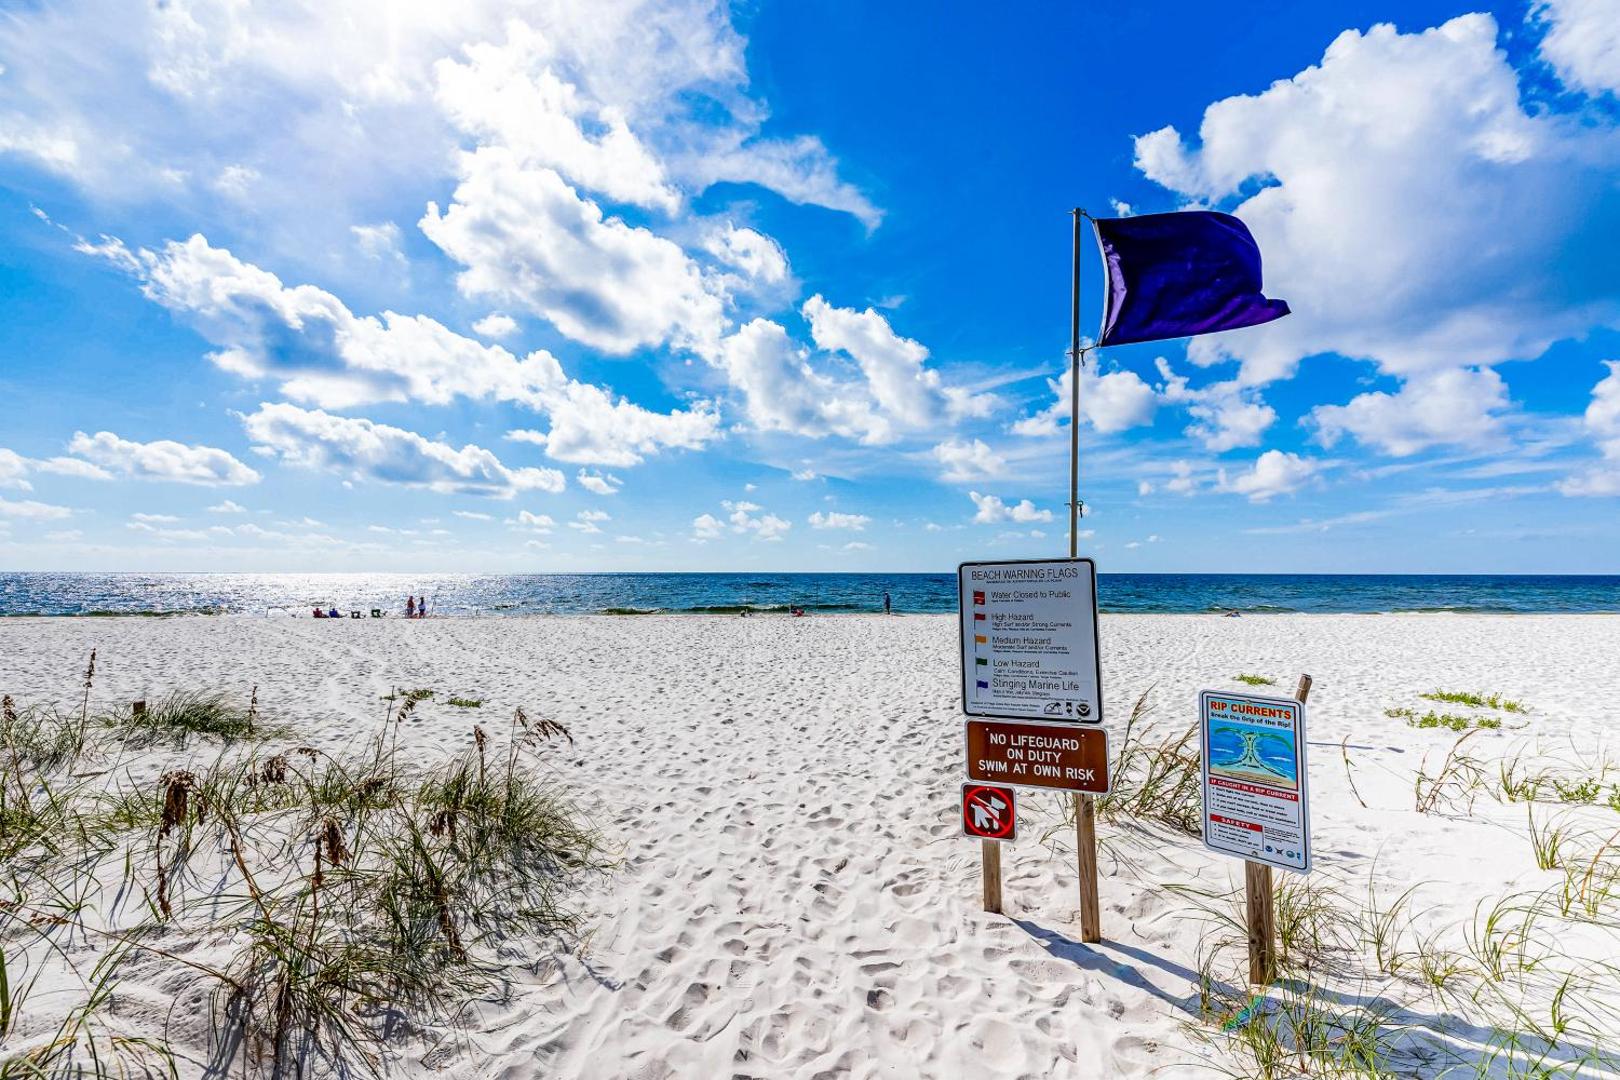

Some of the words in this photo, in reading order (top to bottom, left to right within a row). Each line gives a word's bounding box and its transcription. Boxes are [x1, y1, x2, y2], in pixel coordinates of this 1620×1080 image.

[972, 570, 1000, 580] BEACH
[1002, 568, 1044, 580] WARNING
[1048, 568, 1078, 578] FLAGS
[1013, 591, 1038, 599] Closed
[1049, 590, 1071, 598] Public
[991, 613, 1005, 622] High
[992, 636, 1020, 644] Medium
[1024, 636, 1051, 644] Hazard
[1012, 660, 1039, 668] Hazard
[993, 678, 1026, 690] Stinging
[1029, 680, 1059, 690] Marine
[1062, 680, 1079, 691] Life
[1210, 701, 1228, 711] RIP
[1231, 704, 1292, 720] CURRENTS
[1242, 715, 1255, 723] Grip
[1277, 720, 1291, 728] Rip!
[990, 733, 1006, 745] NO
[1011, 734, 1079, 750] LIFEGUARD
[1007, 748, 1023, 760] ON
[1028, 750, 1062, 763] DUTY
[978, 760, 1008, 773] SWIM
[1013, 762, 1028, 774] AT
[1034, 764, 1060, 778] OWN
[1066, 768, 1095, 781] RISK
[1218, 780, 1240, 790] CAUGHT
[1266, 790, 1295, 800] CURRENT
[1222, 817, 1250, 828] SAFETY
